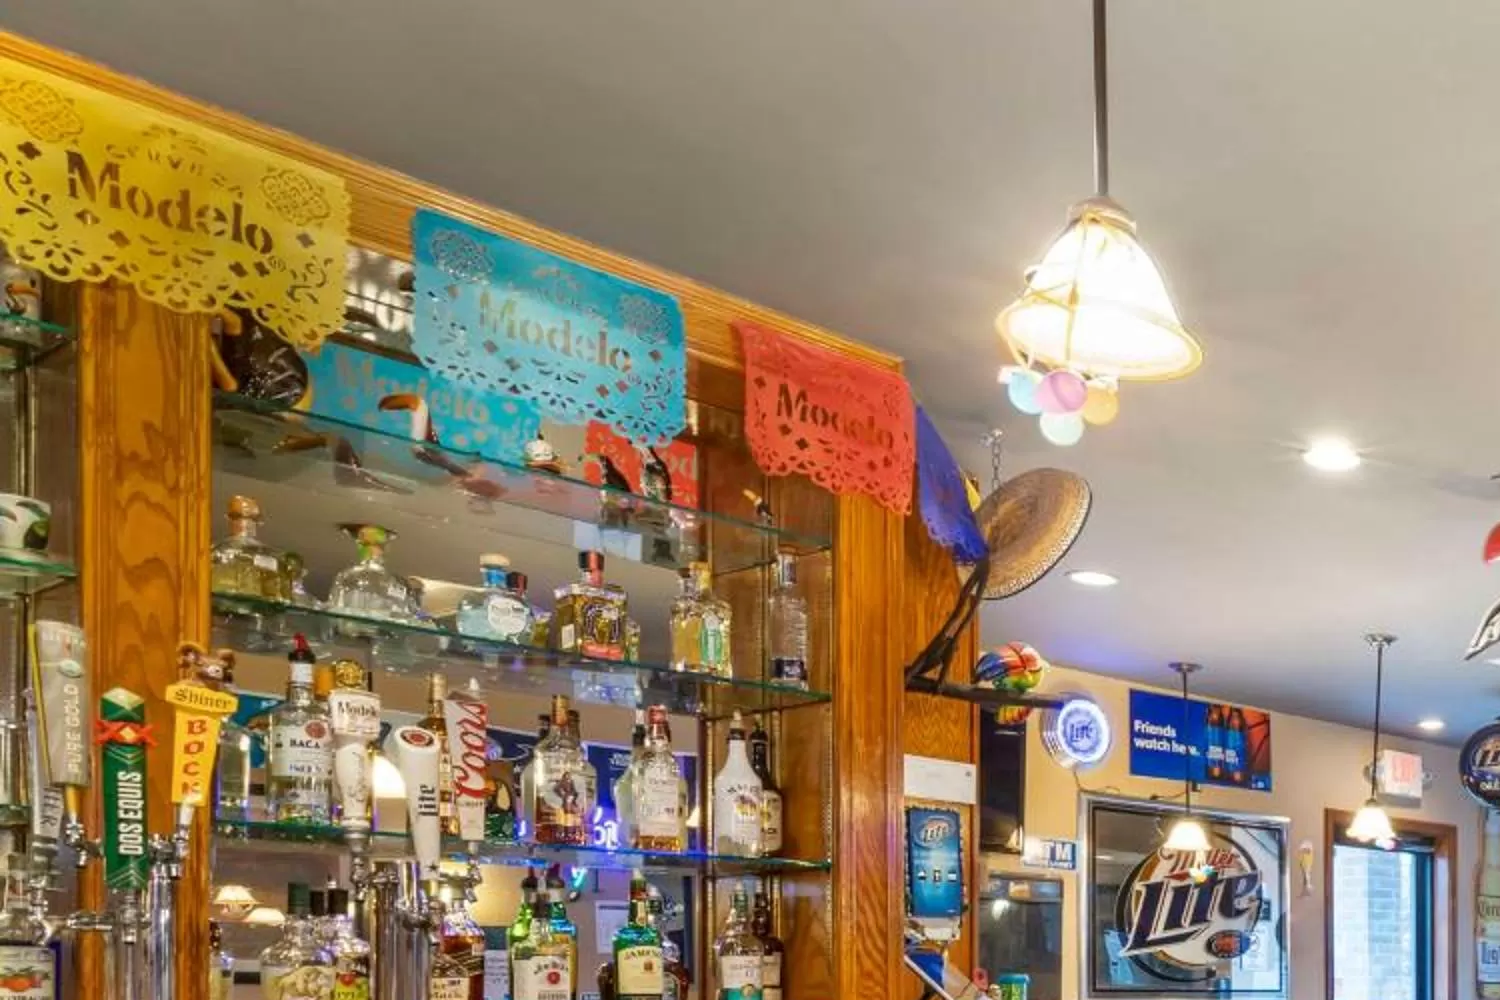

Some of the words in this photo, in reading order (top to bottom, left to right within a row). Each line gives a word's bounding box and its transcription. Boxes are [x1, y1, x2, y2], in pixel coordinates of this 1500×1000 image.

[66, 149, 274, 255] Modelo
[479, 290, 632, 373] Modelo
[776, 383, 894, 449] Modelo
[63, 683, 81, 727] GOLD
[174, 686, 233, 711] Shiner
[450, 701, 490, 799] Coors
[1133, 719, 1177, 738] Friends
[1133, 737, 1170, 752] watch
[116, 770, 143, 820] EQUIS
[118, 822, 145, 856] DOS
[1120, 872, 1262, 956] Lite
